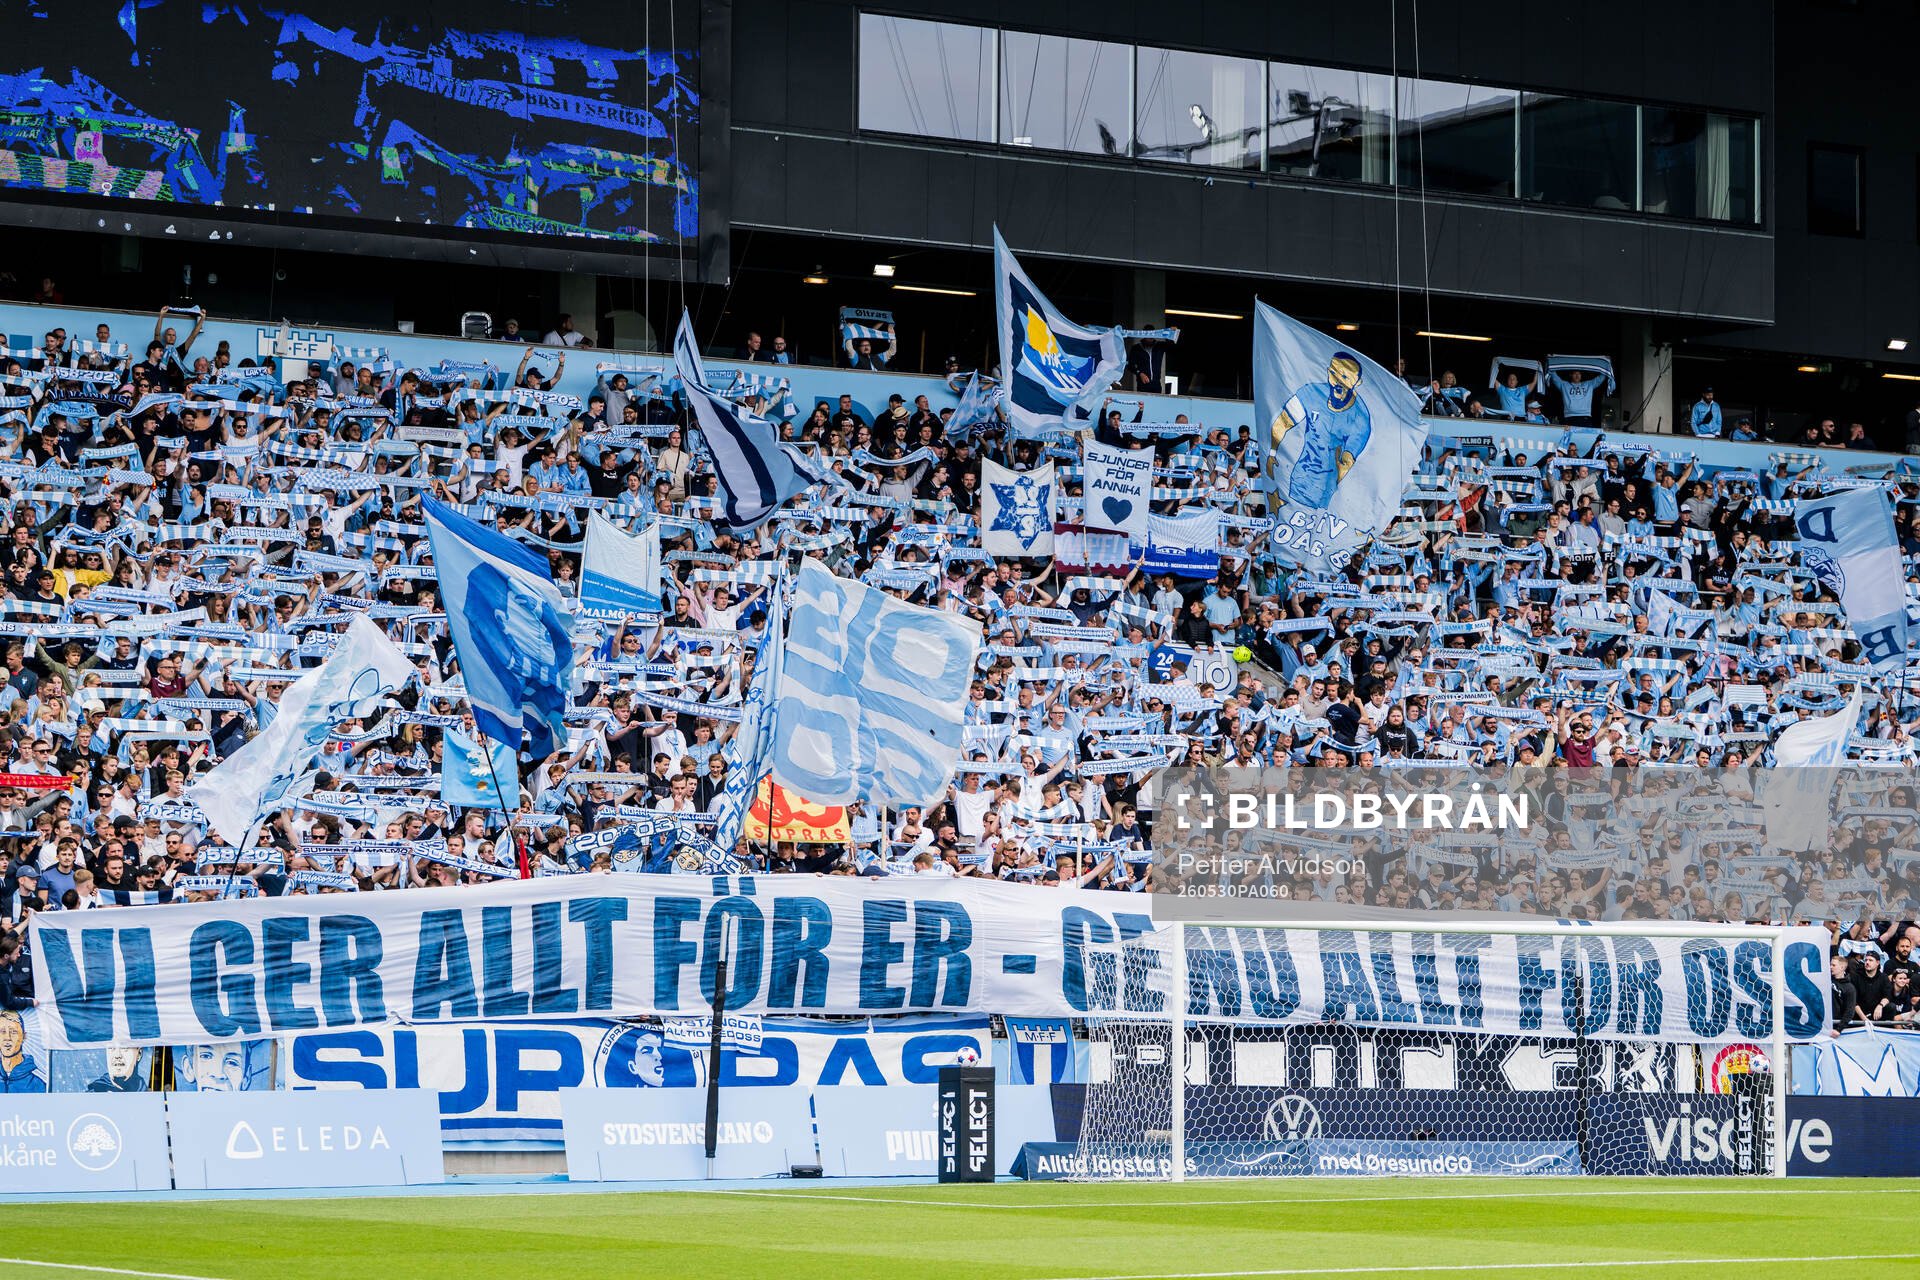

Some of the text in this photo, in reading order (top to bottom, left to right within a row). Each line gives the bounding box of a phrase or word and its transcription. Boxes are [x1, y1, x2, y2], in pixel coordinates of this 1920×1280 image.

[855, 308, 889, 319] Øltras
[1087, 451, 1151, 471] SJUNGER
[1106, 467, 1135, 483] FÖR
[1091, 478, 1141, 498] ANNIKA
[582, 607, 626, 621] MALMÖ
[754, 826, 845, 841] SUPRAS
[38, 927, 161, 1043] VI
[189, 913, 387, 1037] GER
[411, 897, 628, 1020] ALLT
[653, 876, 833, 1011] FÖR
[859, 898, 973, 1008] ER
[1002, 953, 1036, 975] -
[1682, 937, 1825, 1040] OSS
[272, 1125, 391, 1151] ELEDA
[968, 1088, 987, 1173] SELECT
[1037, 1153, 1088, 1173] Alltid
[1093, 1153, 1156, 1178] lägsta
[1319, 1153, 1473, 1174] med ØresundGO
